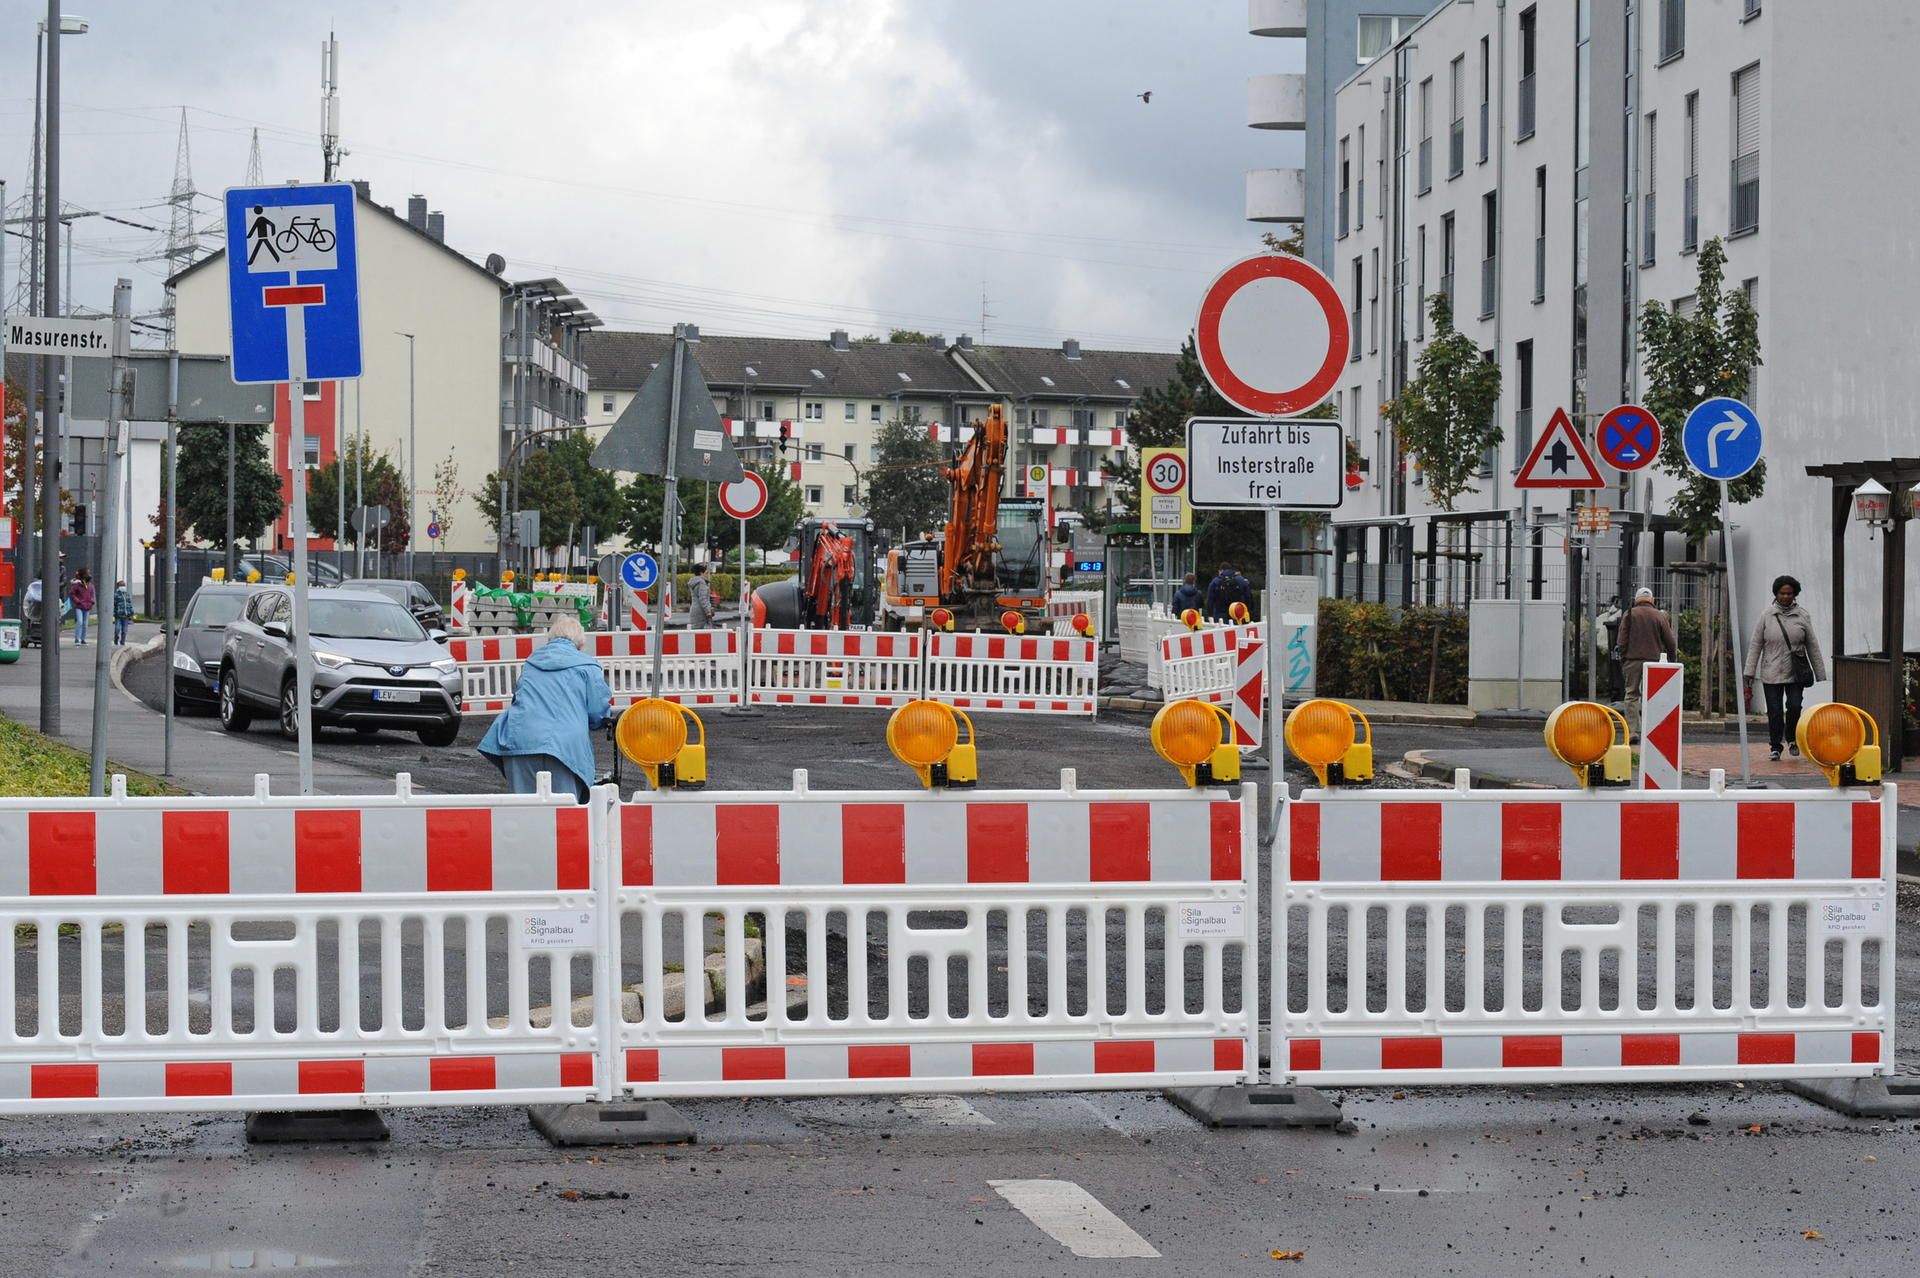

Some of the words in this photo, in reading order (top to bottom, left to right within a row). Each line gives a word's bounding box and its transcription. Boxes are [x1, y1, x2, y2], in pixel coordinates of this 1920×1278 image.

[11, 325, 107, 349] Masurenstr.
[1221, 425, 1282, 445] Zufahrt
[1287, 426, 1311, 445] bis
[1217, 455, 1315, 474] Insterstraße
[1155, 464, 1179, 483] 30
[1248, 480, 1282, 499] frei
[1080, 562, 1102, 571] 15:13
[1186, 908, 1202, 917] Sila
[1828, 905, 1843, 913] Sila
[530, 917, 547, 926] Sila
[1186, 916, 1227, 926] Signalbau
[1828, 912, 1866, 922] Signalbau
[530, 925, 574, 936] Signalbau
